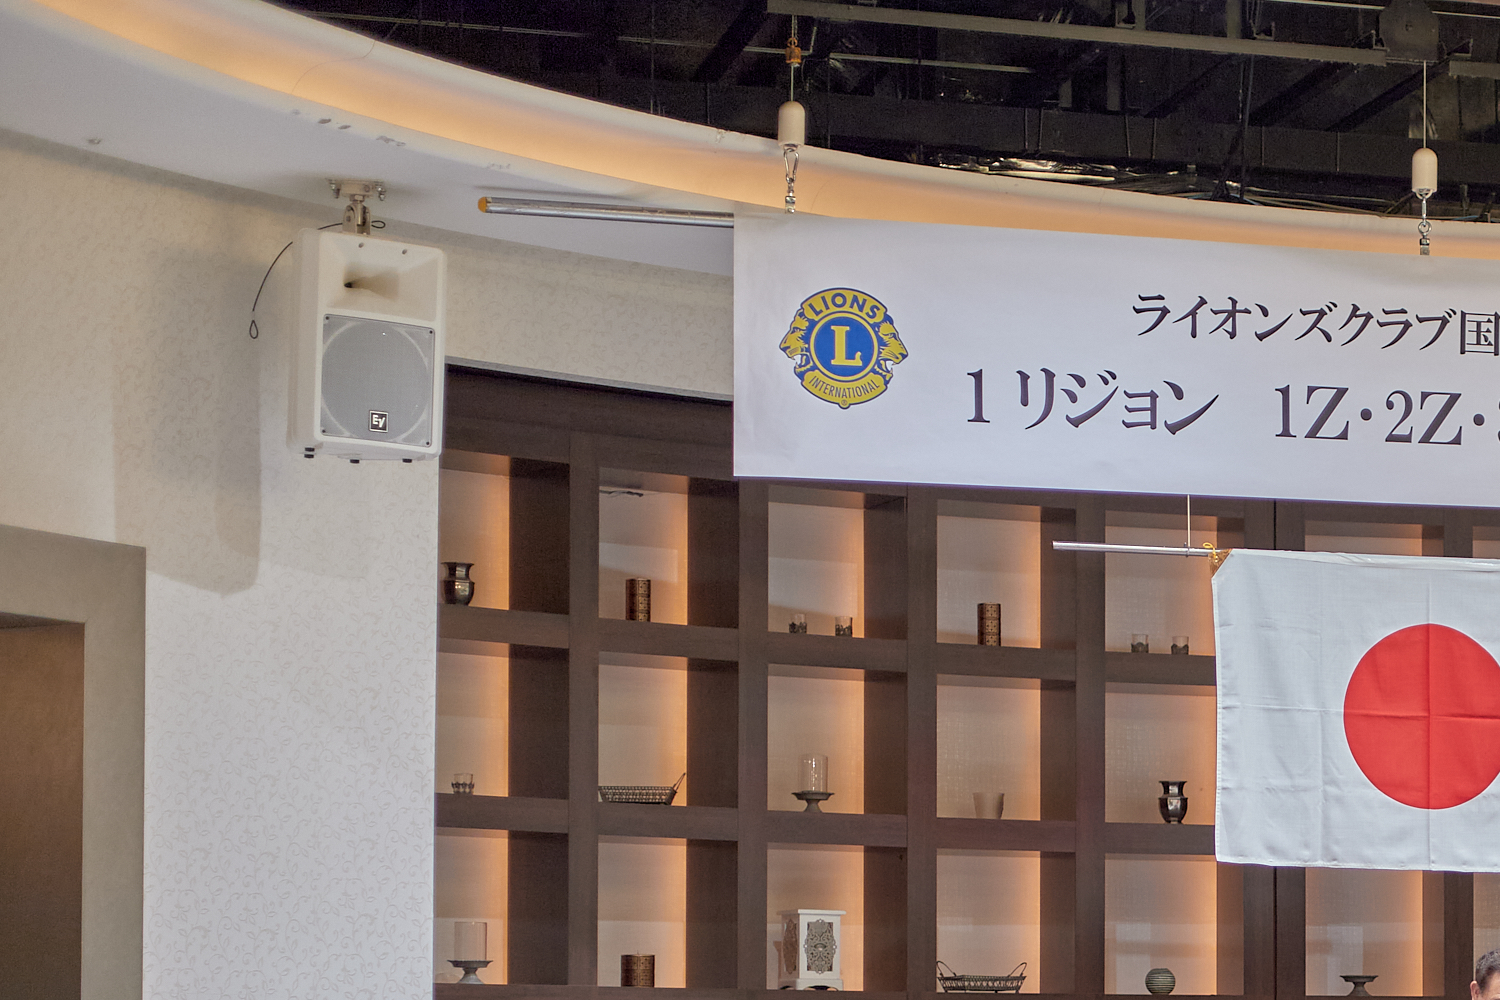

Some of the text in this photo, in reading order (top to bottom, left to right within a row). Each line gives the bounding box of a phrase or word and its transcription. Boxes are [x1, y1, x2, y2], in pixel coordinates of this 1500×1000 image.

[808, 292, 880, 320] LIONS
[830, 325, 863, 366] L
[808, 374, 880, 399] INTERNATIONAL
